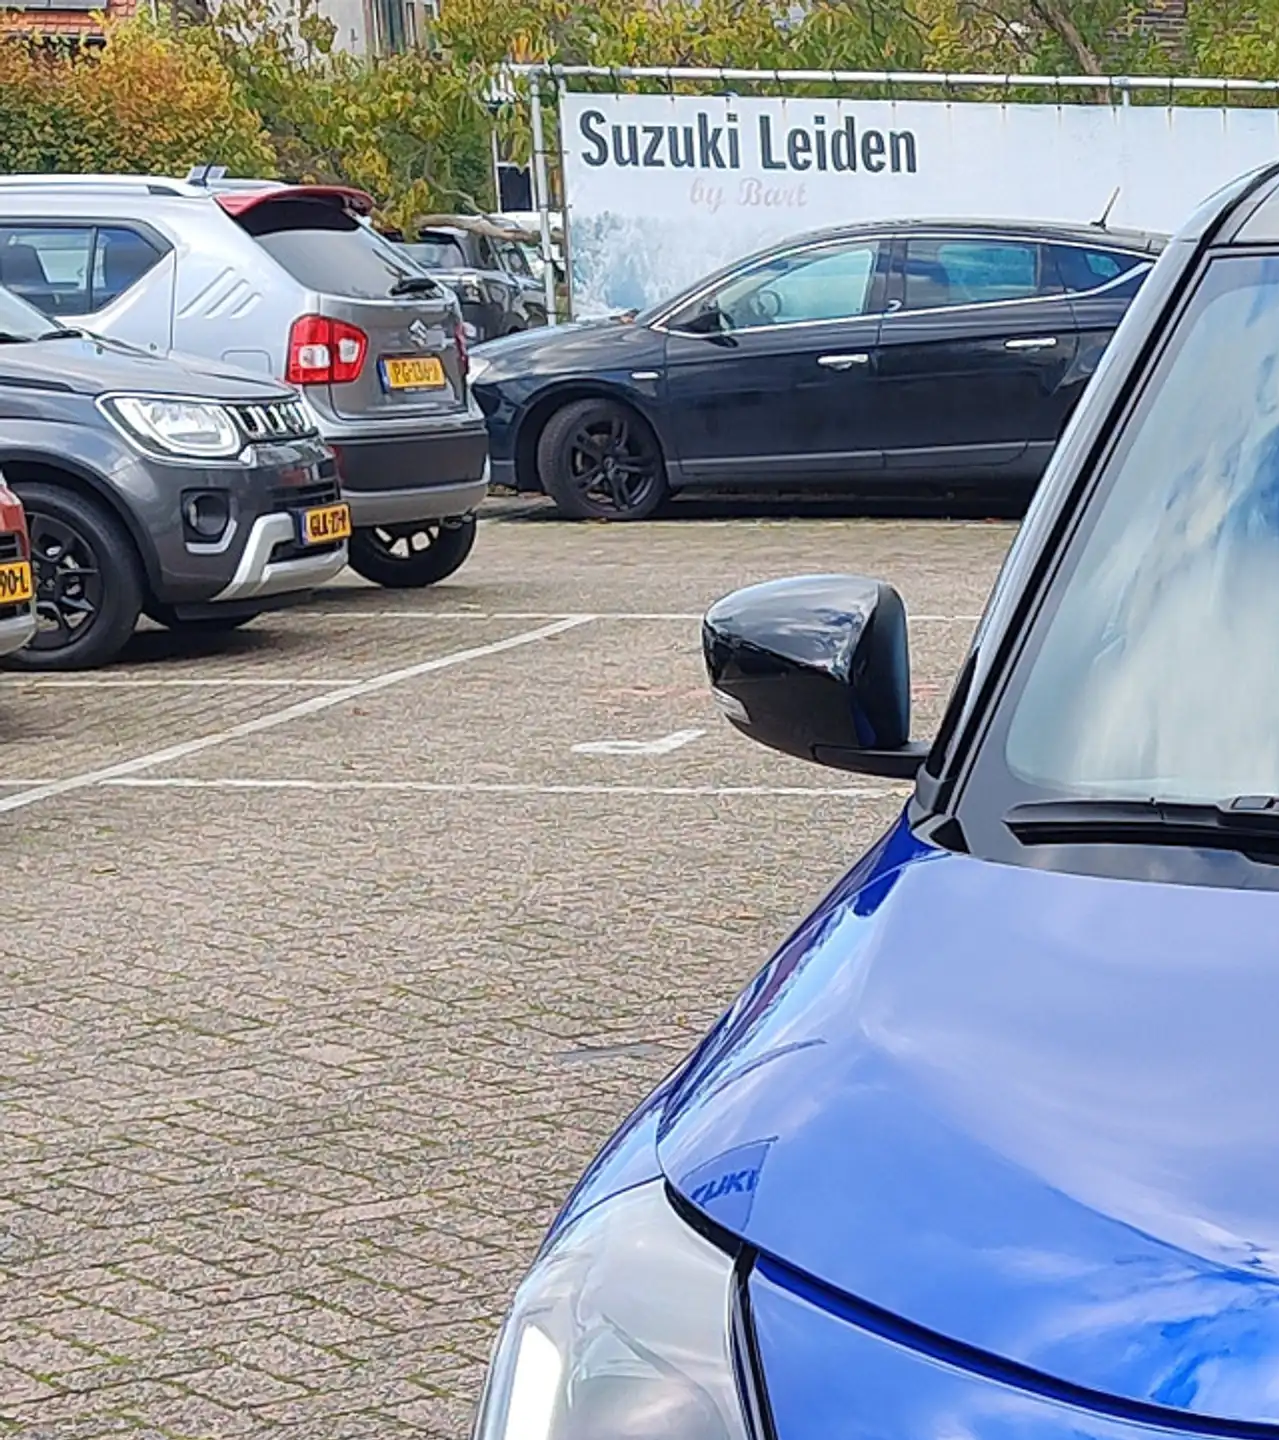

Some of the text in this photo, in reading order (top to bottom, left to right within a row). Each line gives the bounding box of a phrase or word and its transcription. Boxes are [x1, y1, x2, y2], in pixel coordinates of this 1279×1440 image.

[579, 109, 917, 174] Suzuki Leiden
[689, 176, 808, 215] by Bart
